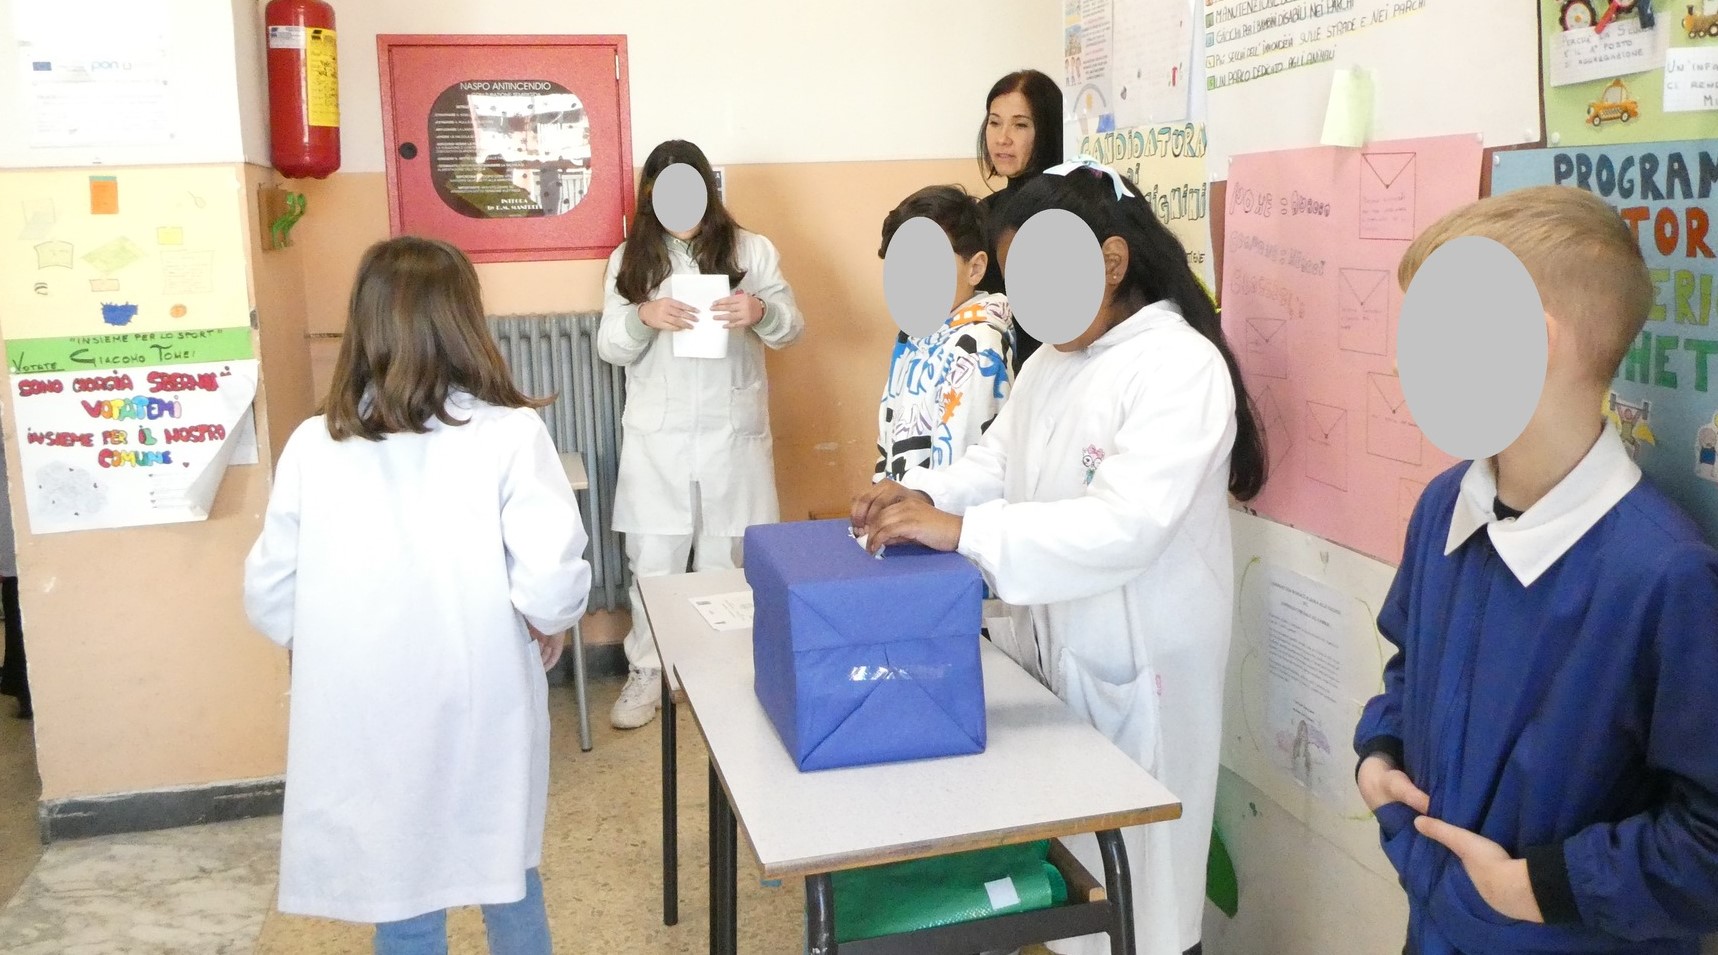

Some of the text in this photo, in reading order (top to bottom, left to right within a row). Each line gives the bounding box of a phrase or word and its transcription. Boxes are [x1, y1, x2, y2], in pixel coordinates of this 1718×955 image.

[460, 82, 551, 91] NASPO ANTINCENDIO
[1614, 205, 1718, 258] TOR
[1648, 268, 1718, 326] ERI
[134, 333, 156, 341] PER
[160, 332, 173, 340] LO
[1615, 331, 1718, 392] HET
[102, 429, 128, 445] PER
[98, 448, 173, 468] COMUNE
